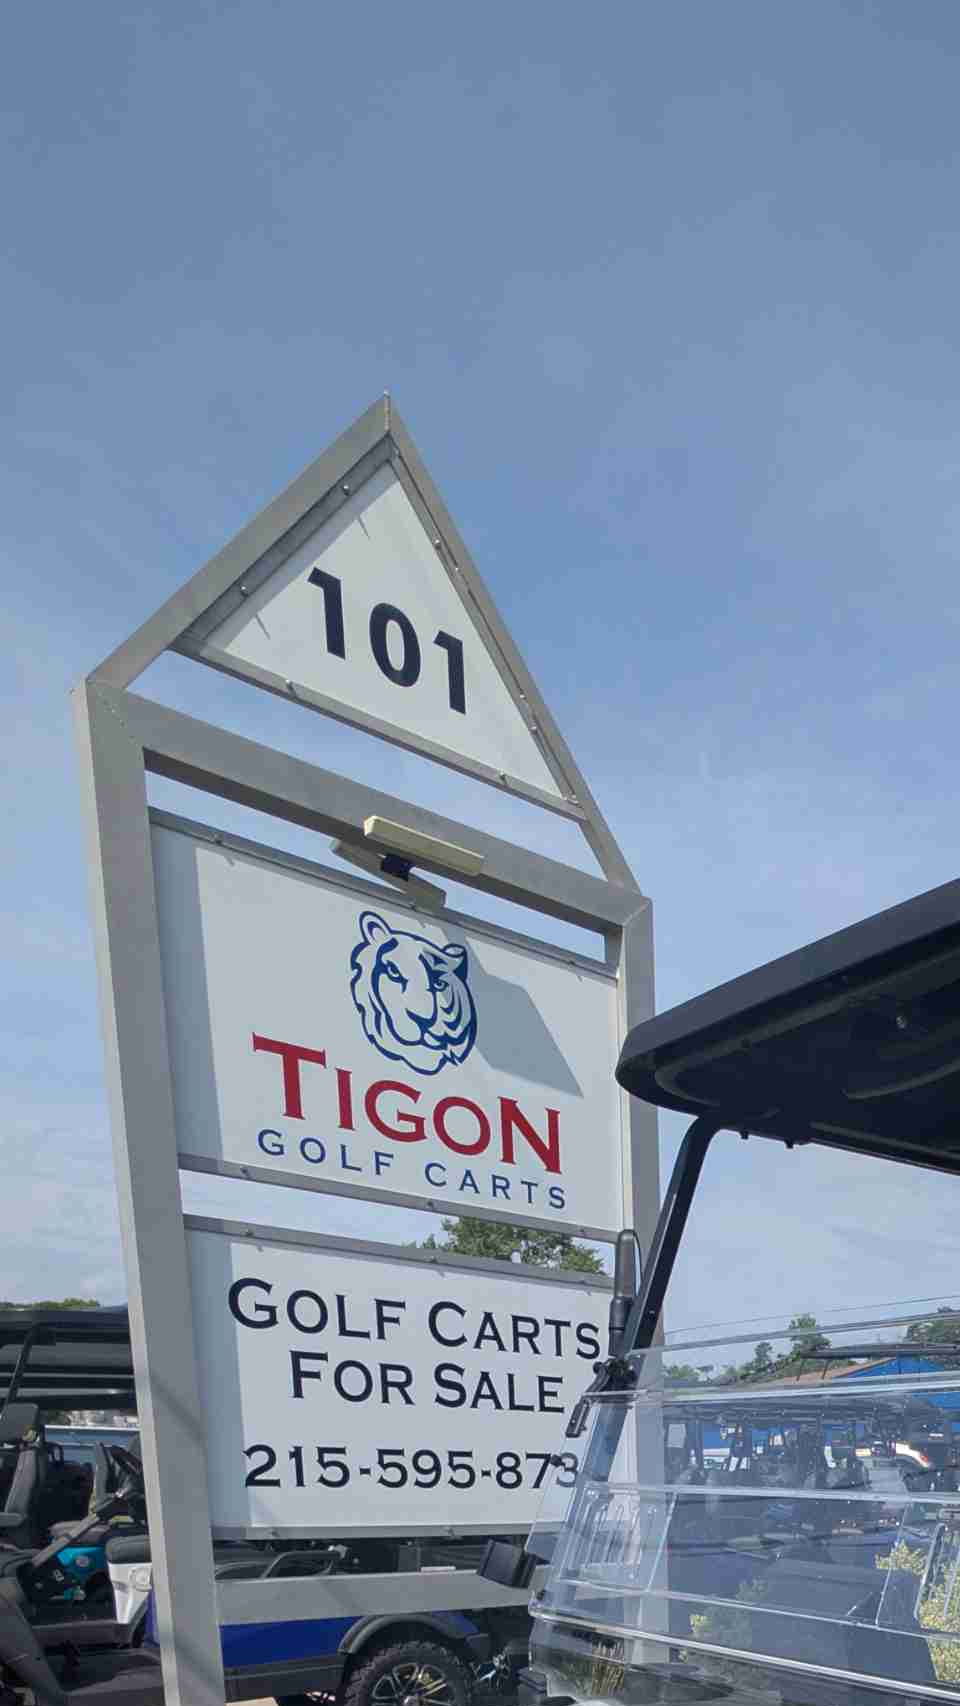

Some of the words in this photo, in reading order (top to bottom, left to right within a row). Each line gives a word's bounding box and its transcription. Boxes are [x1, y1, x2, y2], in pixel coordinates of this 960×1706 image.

[307, 567, 467, 716] 101
[251, 1031, 564, 1176] TIGON
[256, 1128, 395, 1177] GOLF
[424, 1162, 567, 1211] CARTS
[227, 1277, 406, 1342] GOLF
[427, 1300, 601, 1360] CARTS
[289, 1350, 415, 1406] FOR
[433, 1362, 565, 1414] SALE
[241, 1443, 580, 1490] 215-595-873
